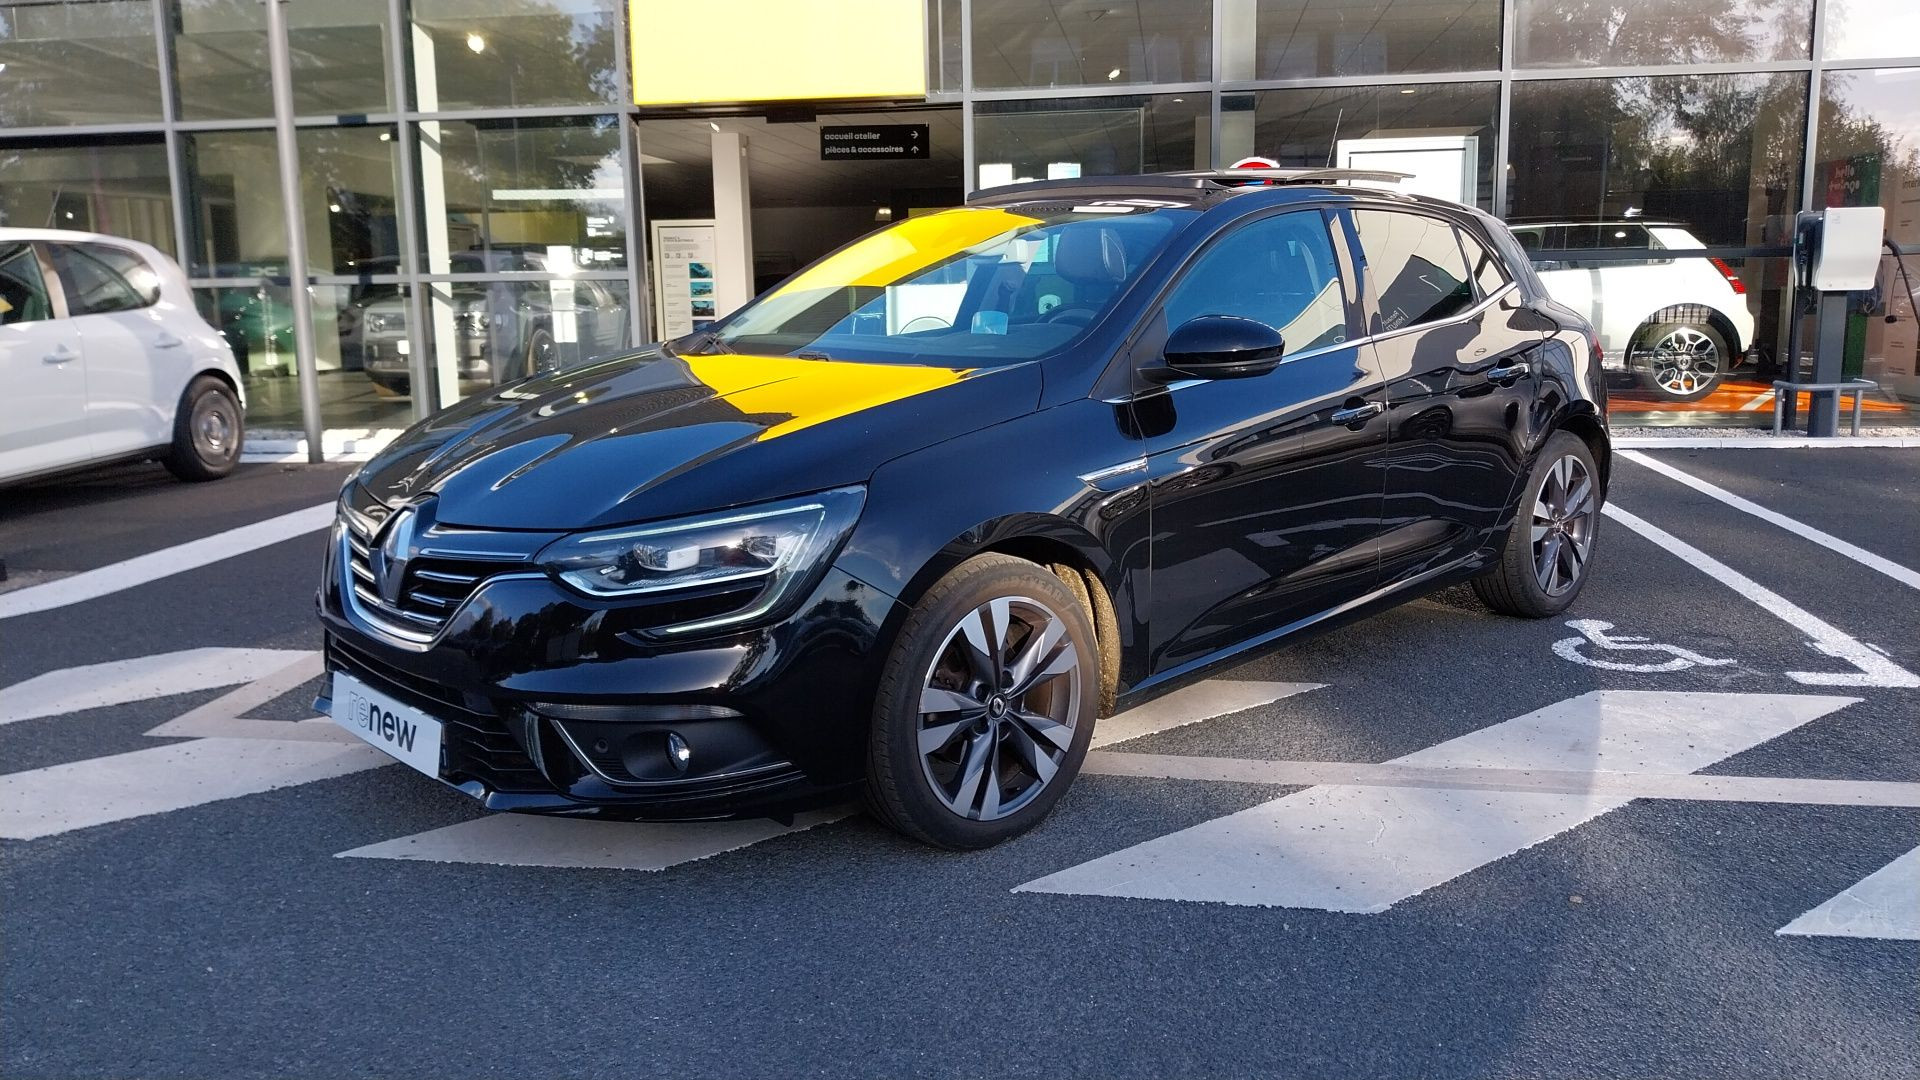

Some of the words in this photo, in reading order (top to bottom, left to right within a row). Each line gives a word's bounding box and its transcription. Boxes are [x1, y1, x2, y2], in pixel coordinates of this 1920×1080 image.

[824, 132, 853, 140] accueil
[854, 131, 881, 140] atelier
[825, 146, 850, 155] pièces
[857, 145, 904, 153] accessoires
[348, 690, 417, 752] renew
